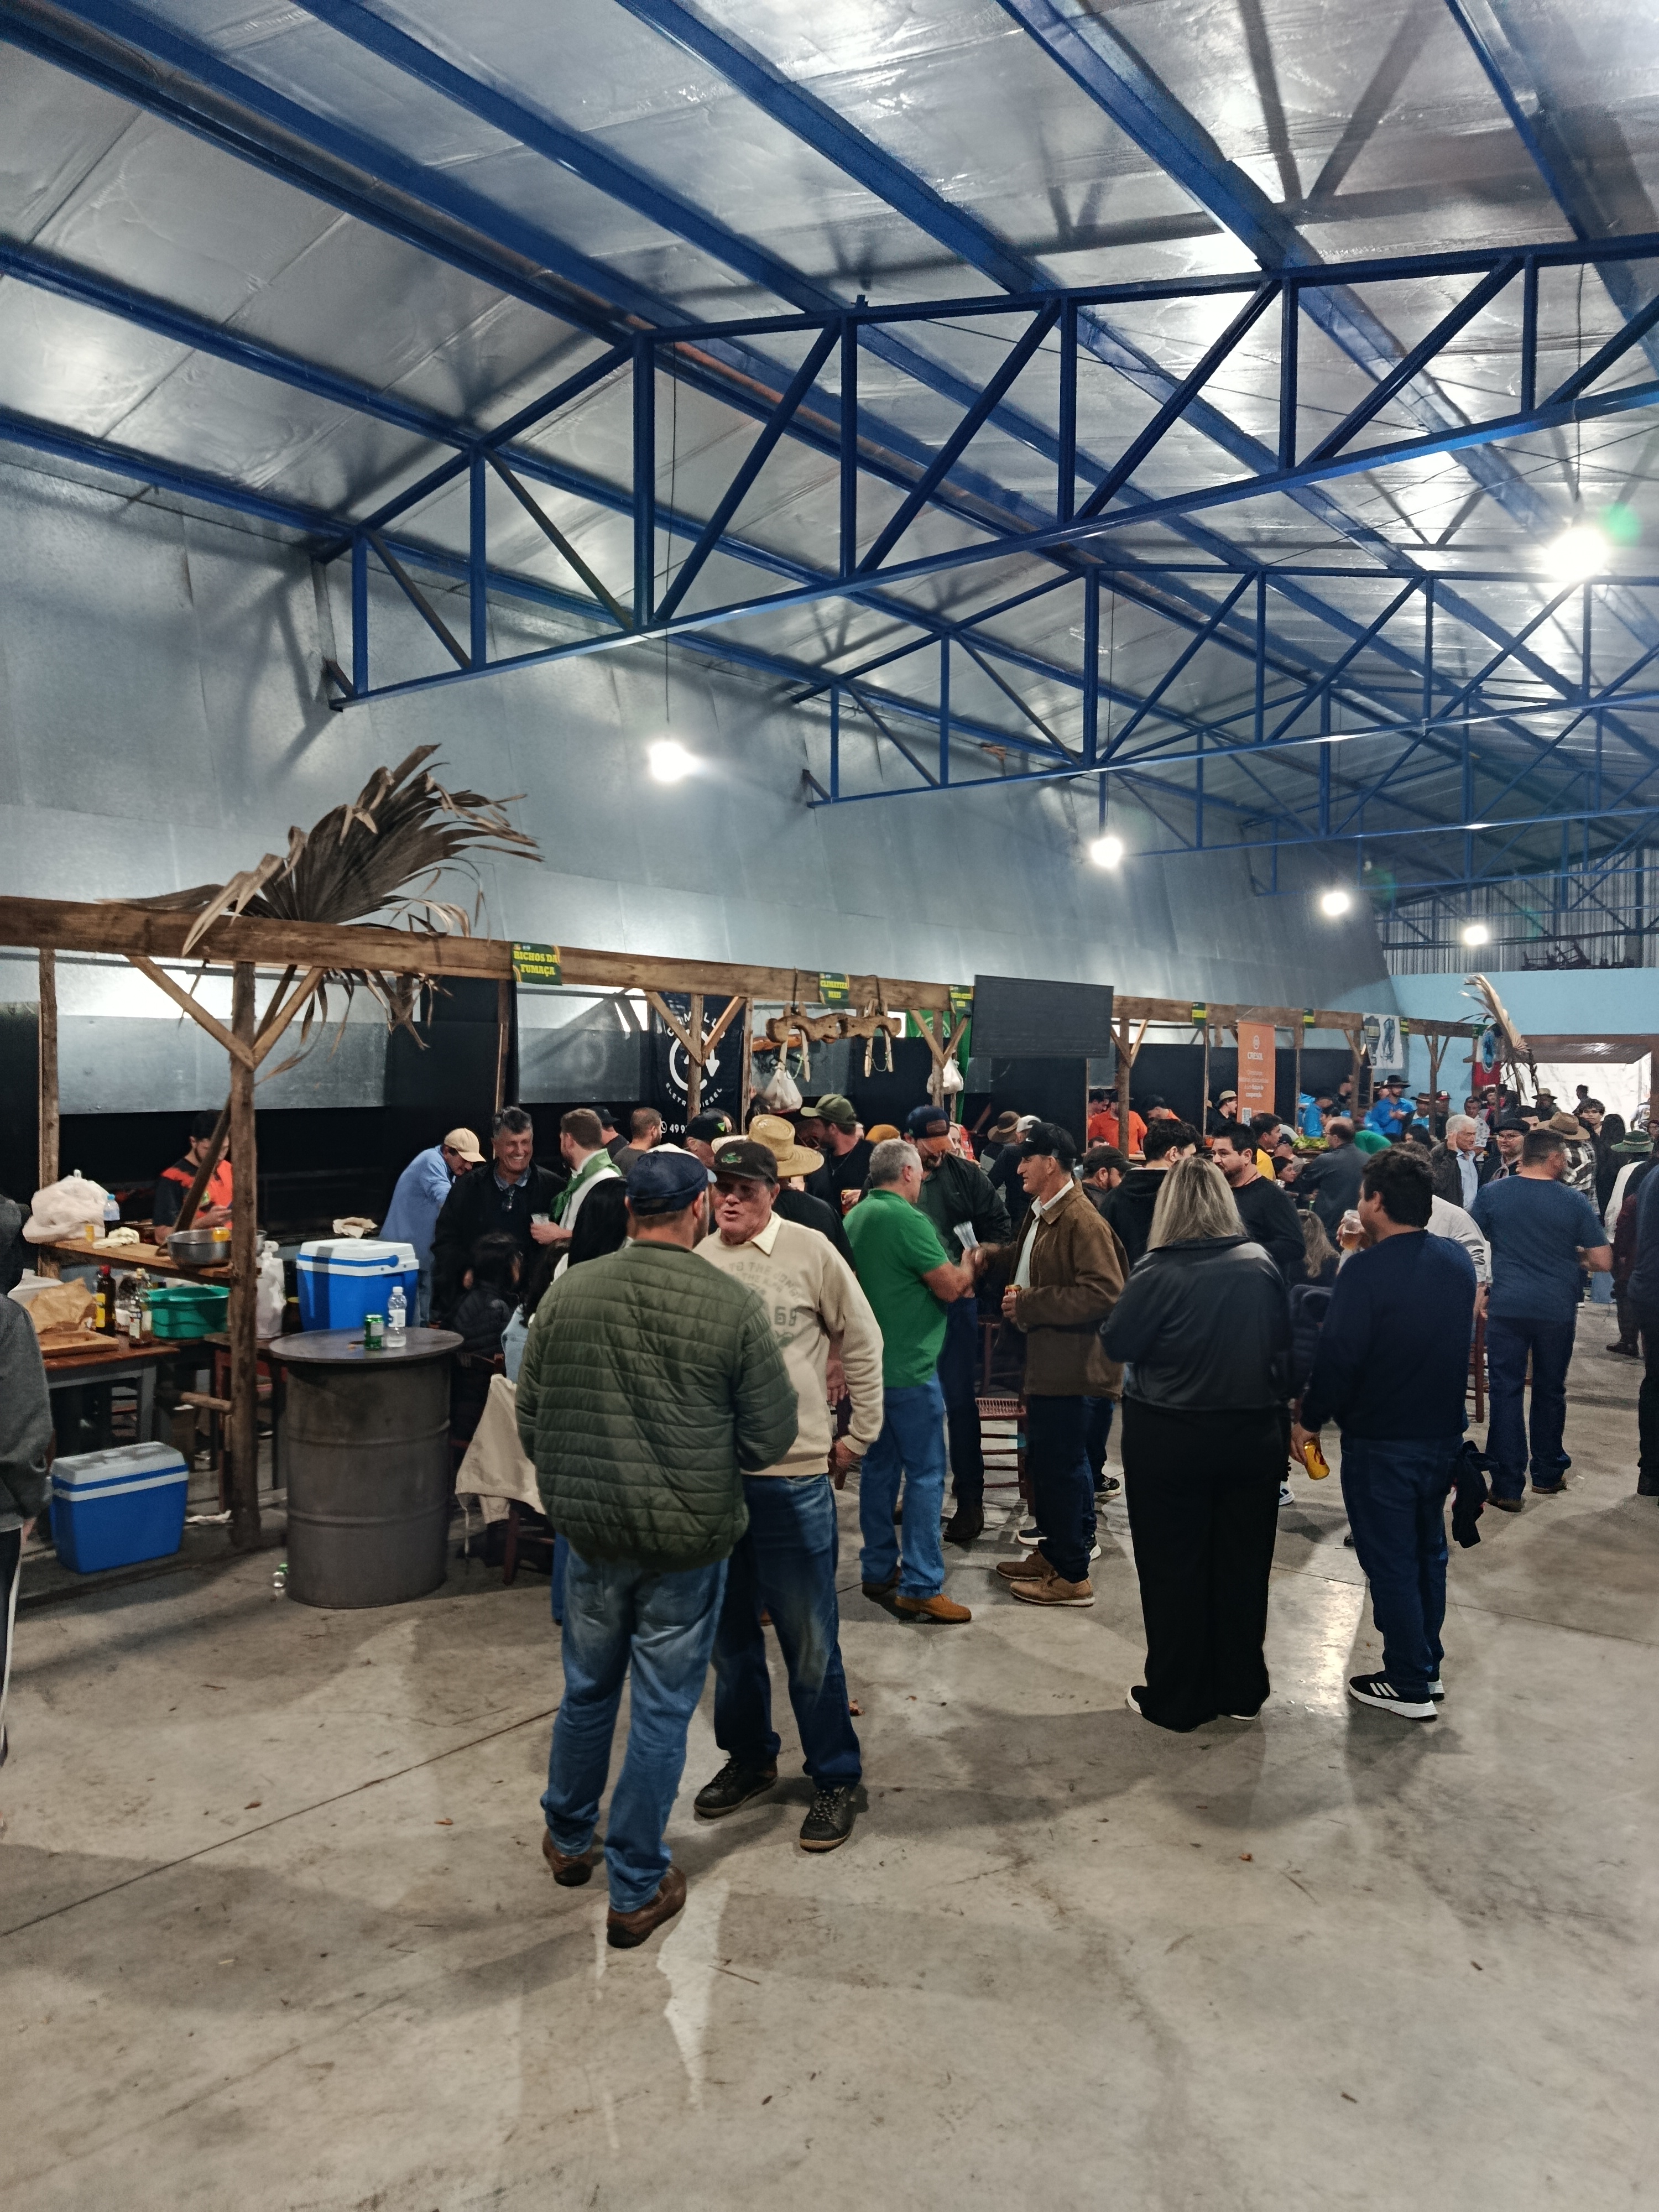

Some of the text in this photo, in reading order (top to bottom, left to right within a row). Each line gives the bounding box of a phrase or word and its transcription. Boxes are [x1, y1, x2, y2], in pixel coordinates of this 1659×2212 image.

[513, 951, 545, 962] BICHOS
[520, 964, 555, 977] FUMAÇA
[666, 1082, 687, 1107] ELETR
